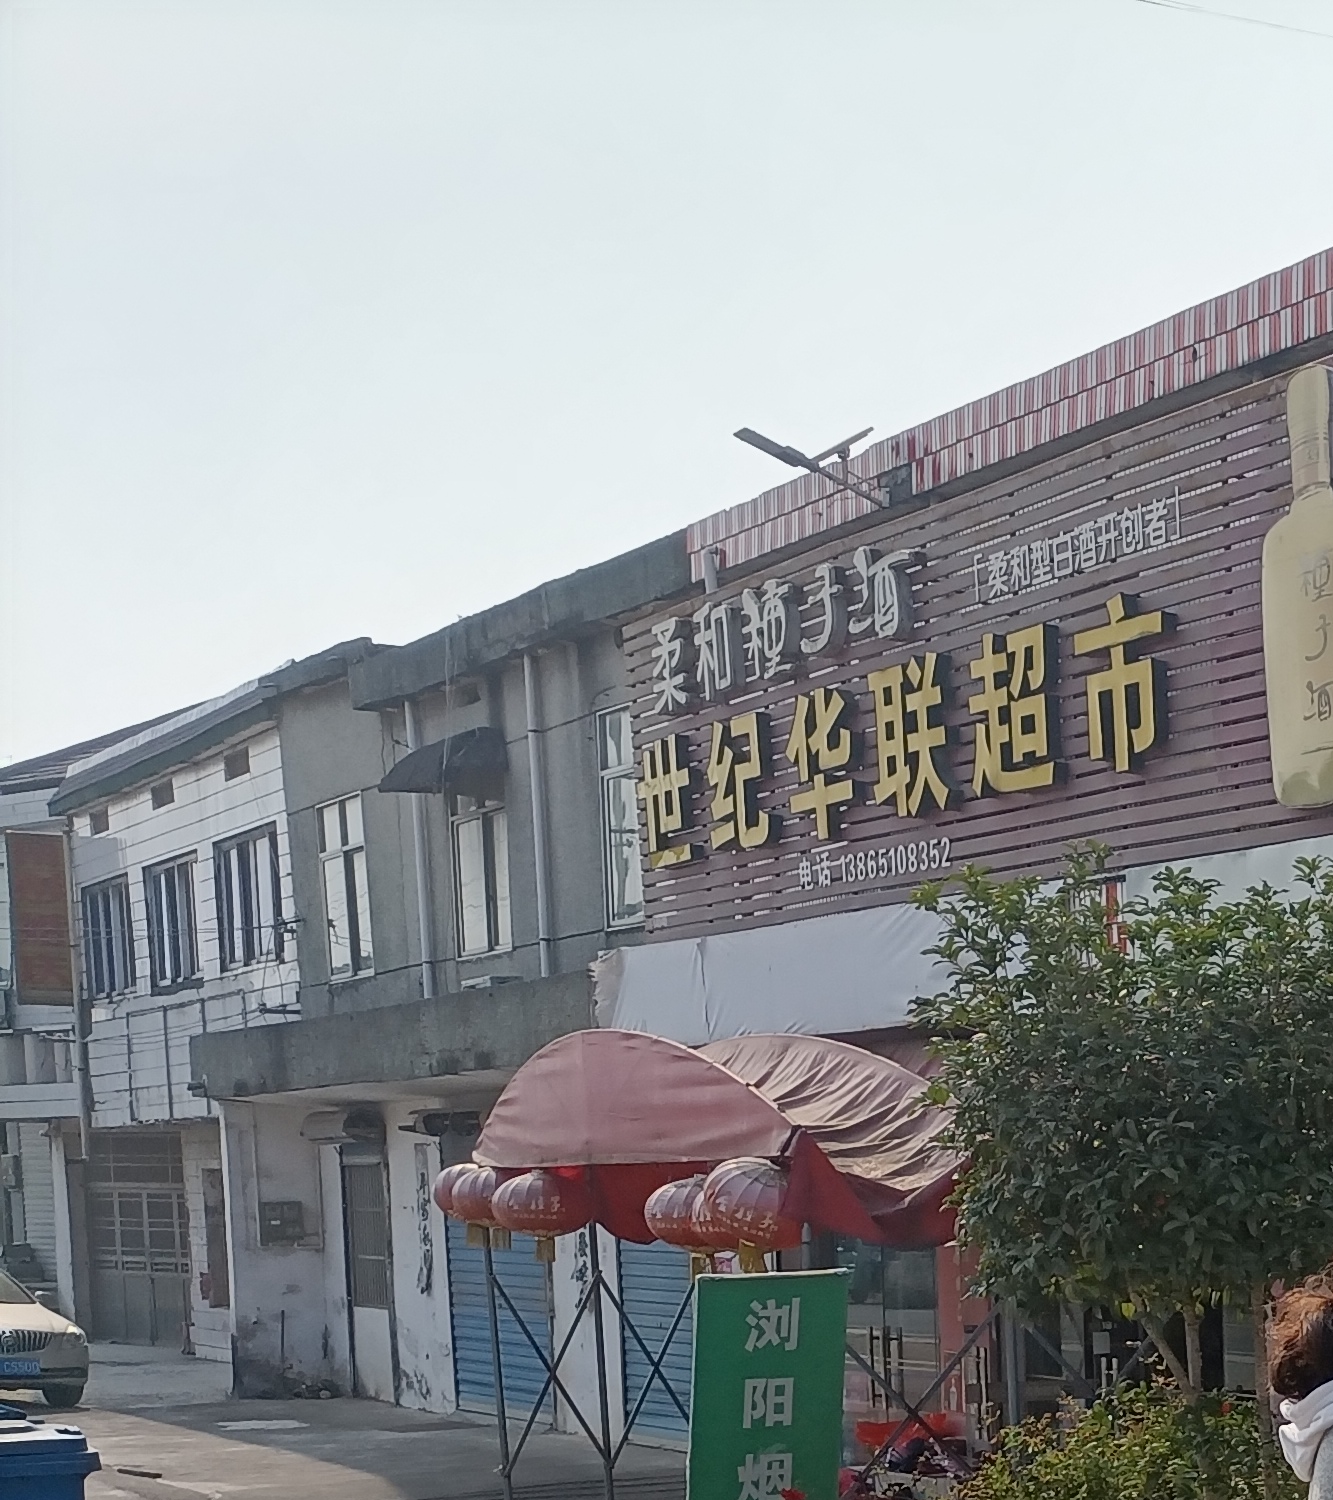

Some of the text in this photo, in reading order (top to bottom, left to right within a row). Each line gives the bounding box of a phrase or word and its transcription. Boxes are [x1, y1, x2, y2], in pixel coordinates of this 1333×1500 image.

[636, 592, 1167, 869] 世纪华联超市
[799, 837, 951, 890] 电话 13865108352
